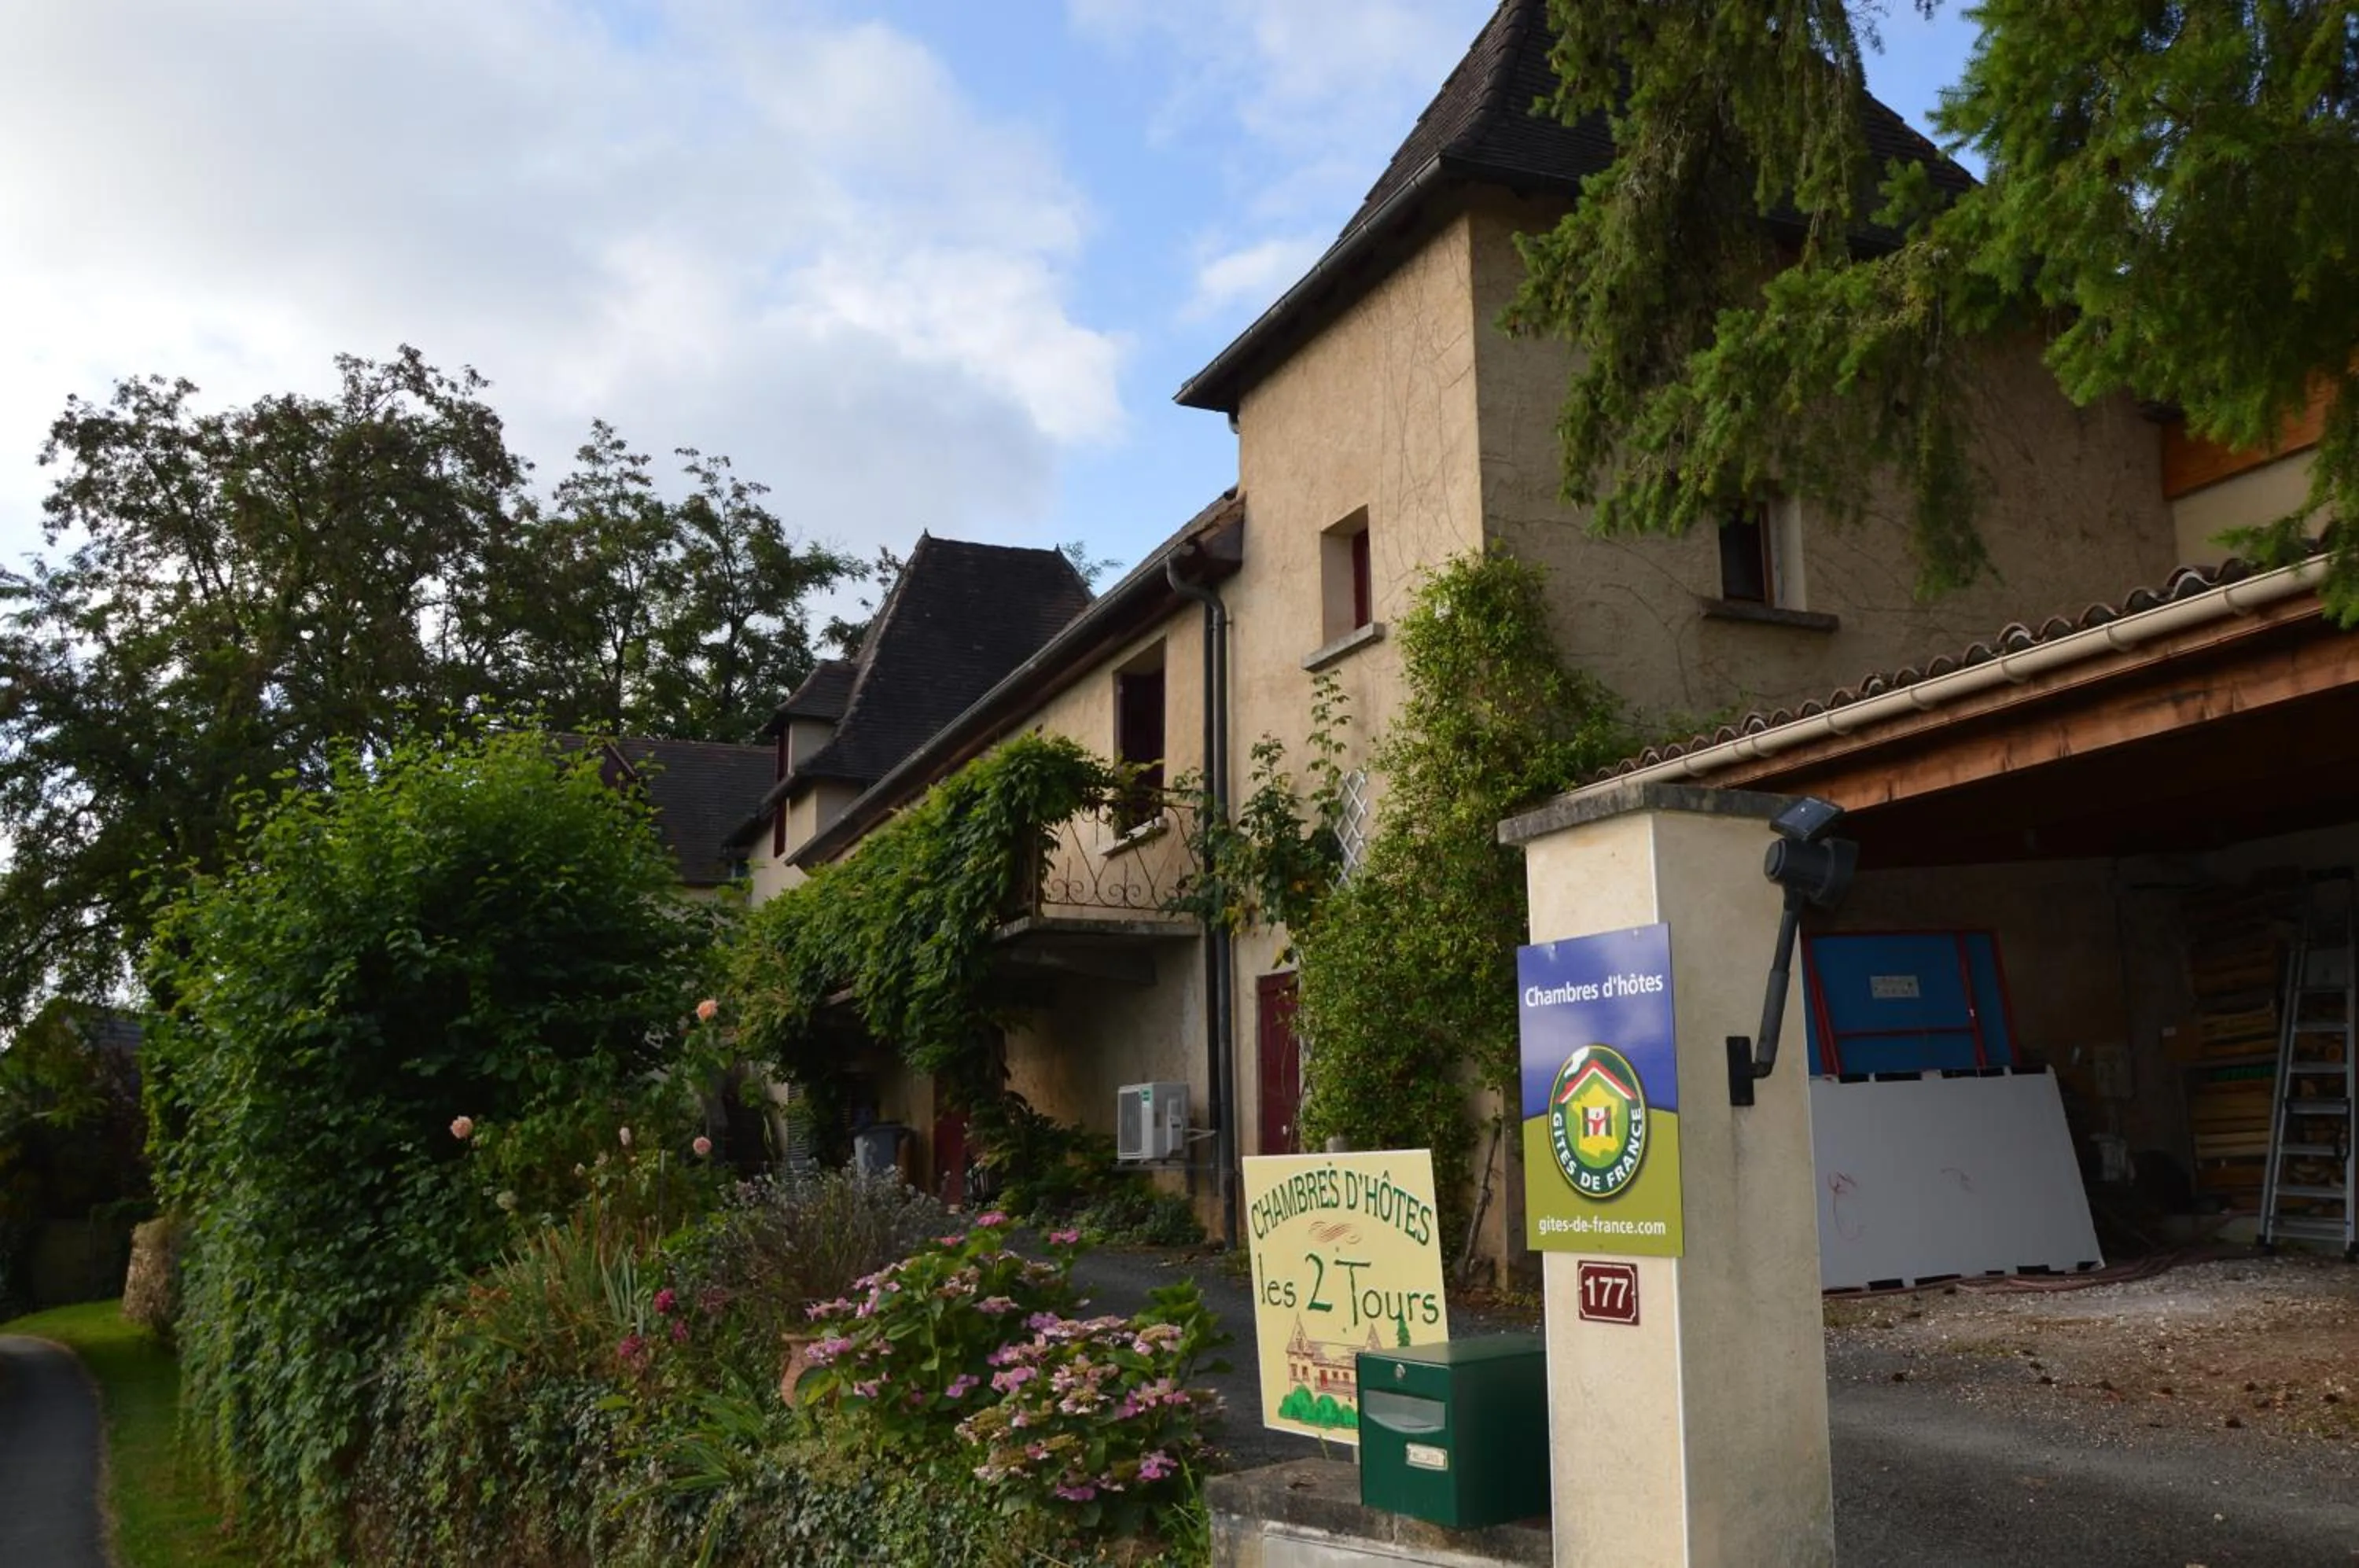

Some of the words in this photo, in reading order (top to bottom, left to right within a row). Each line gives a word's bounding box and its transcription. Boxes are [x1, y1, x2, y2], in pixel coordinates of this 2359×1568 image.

[1525, 981, 1599, 1007] Chambres
[1602, 974, 1663, 998] d'hôtes
[1580, 1172, 1601, 1191] DE
[1606, 1107, 1642, 1188] FRANCE
[1251, 1169, 1340, 1240] CHAMBRES
[1345, 1169, 1432, 1246] D'HÔTES
[1539, 1215, 1666, 1235] gites-de-france.com
[1257, 1252, 1297, 1309] les
[1305, 1253, 1333, 1312] 2
[1334, 1259, 1439, 1328] Tours
[1584, 1275, 1628, 1309] 177
